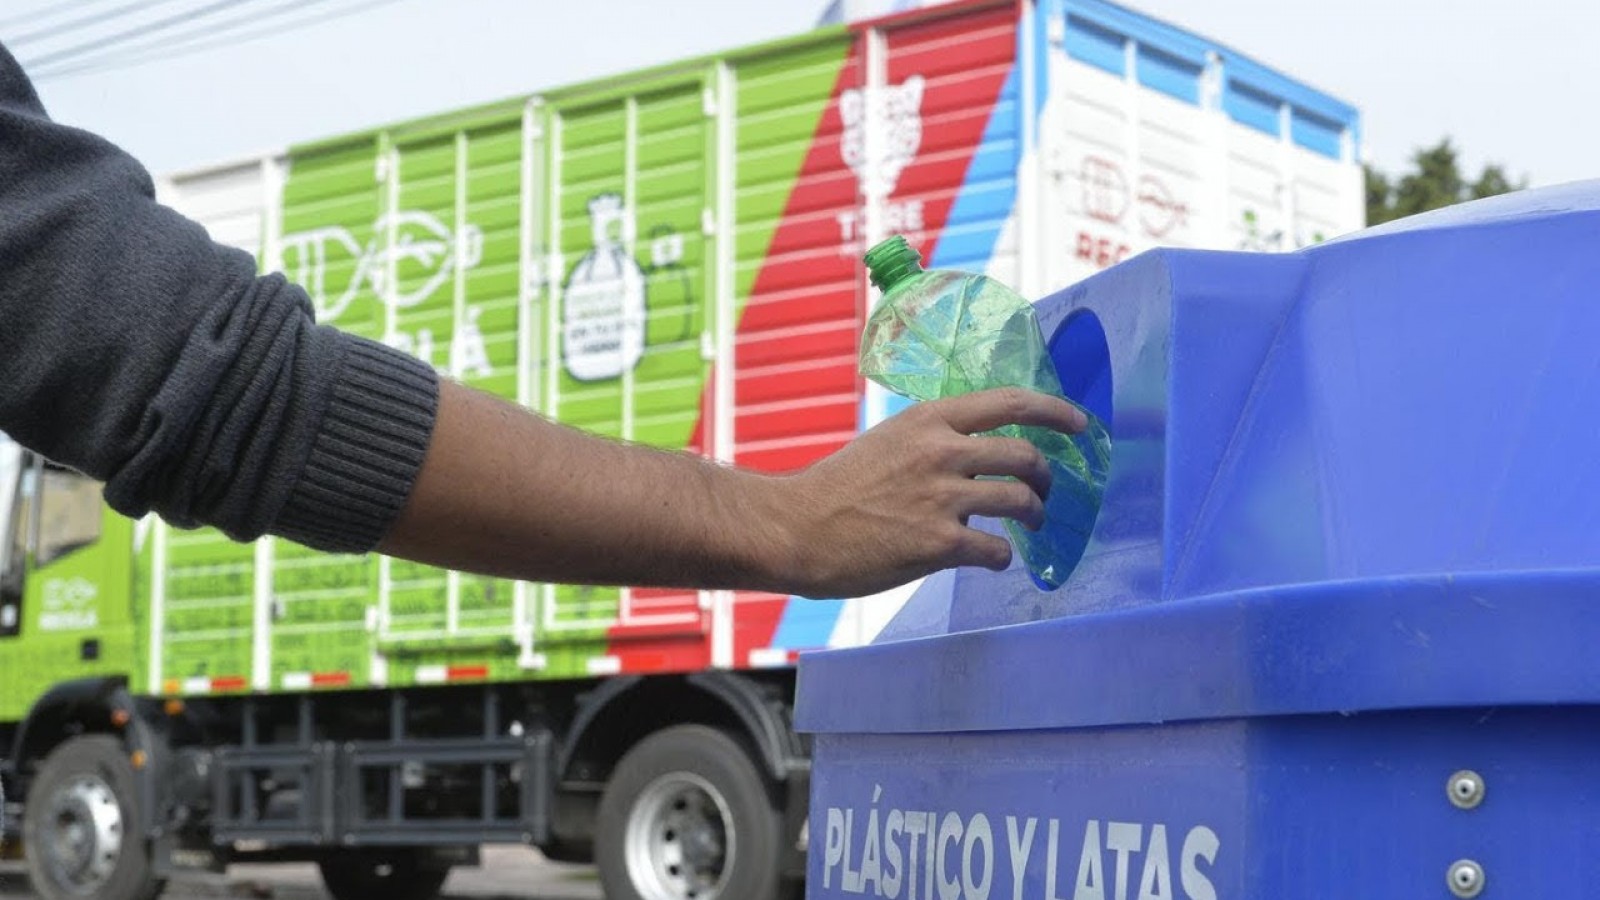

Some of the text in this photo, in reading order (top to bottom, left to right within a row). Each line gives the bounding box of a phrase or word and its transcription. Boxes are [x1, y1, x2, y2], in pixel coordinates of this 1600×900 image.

[823, 784, 1221, 900] PLÁSTICO Y LATAS
